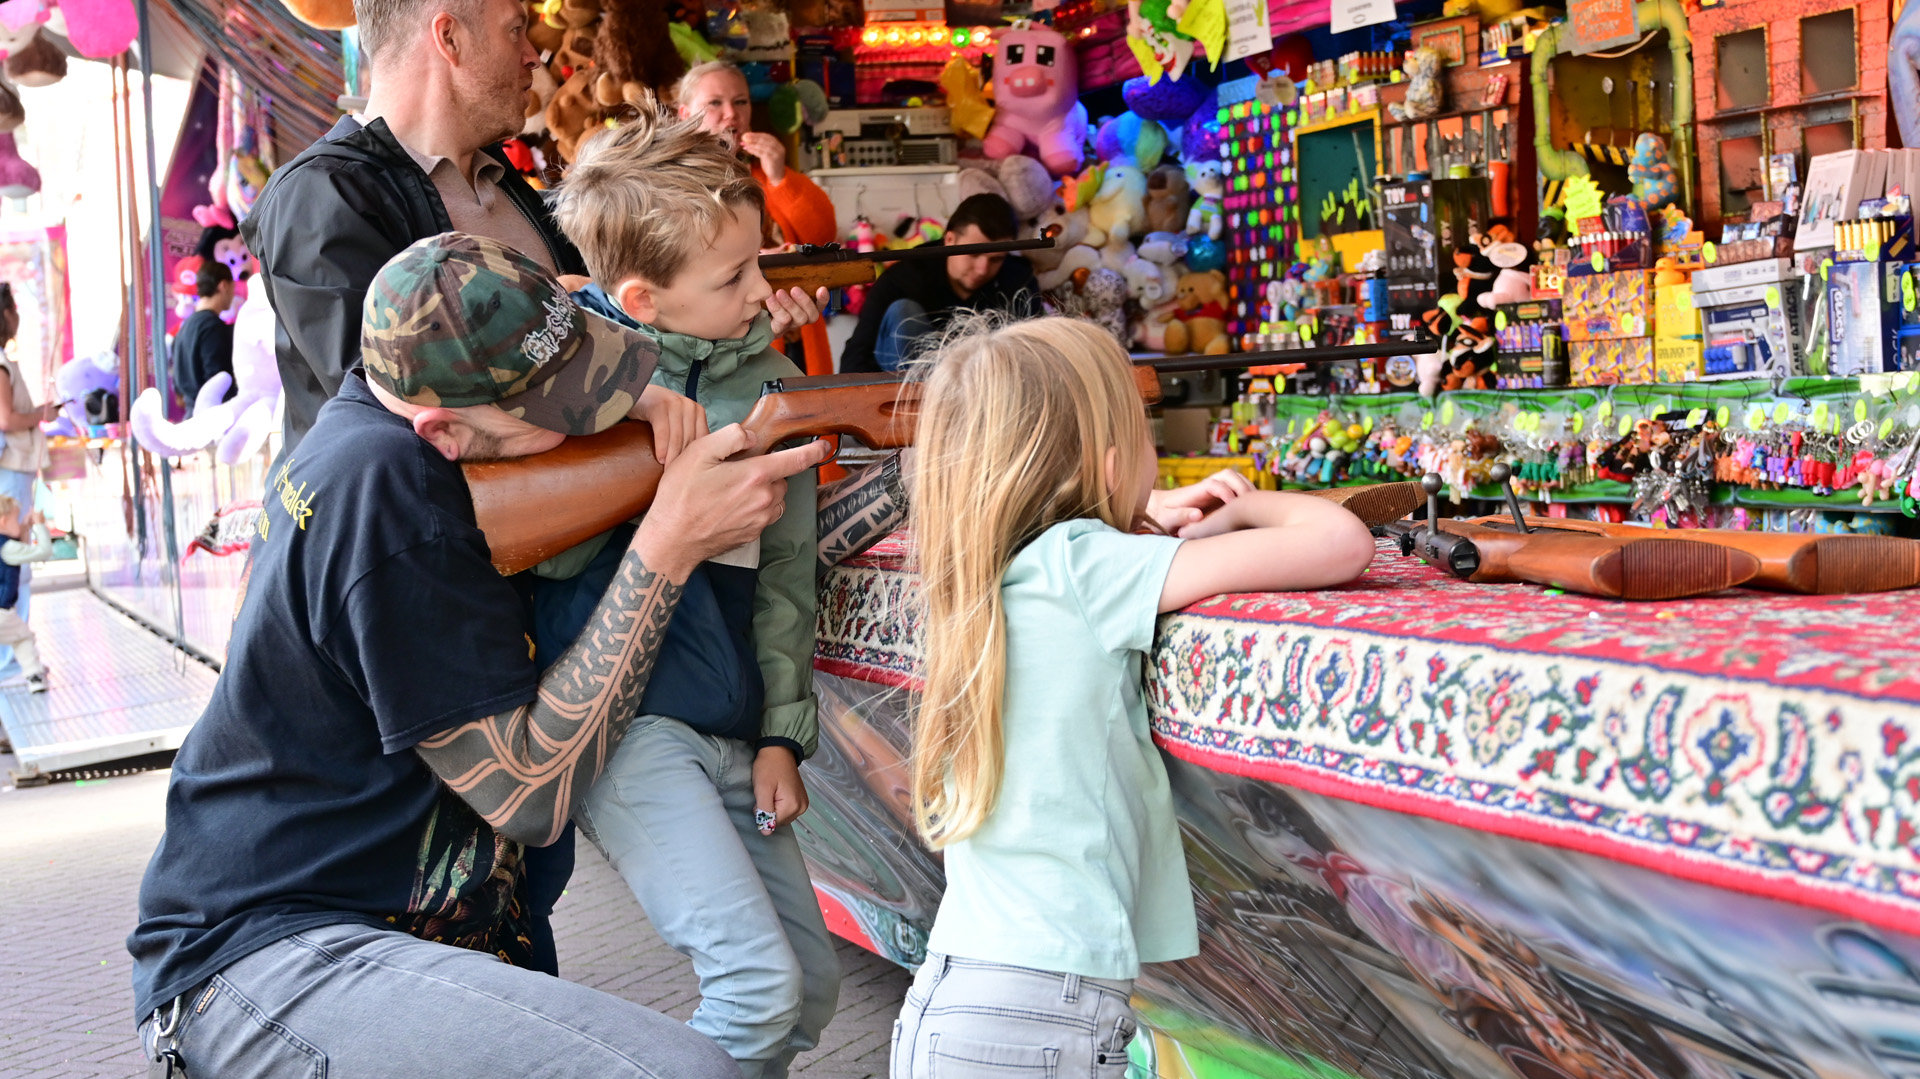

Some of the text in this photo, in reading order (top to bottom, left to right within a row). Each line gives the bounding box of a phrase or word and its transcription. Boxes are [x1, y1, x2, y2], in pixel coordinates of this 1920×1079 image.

[1384, 187, 1406, 204] TOY
[1390, 313, 1412, 330] TOY
[1785, 285, 1799, 336] ATTACK
[1833, 289, 1845, 340] GLOCK
